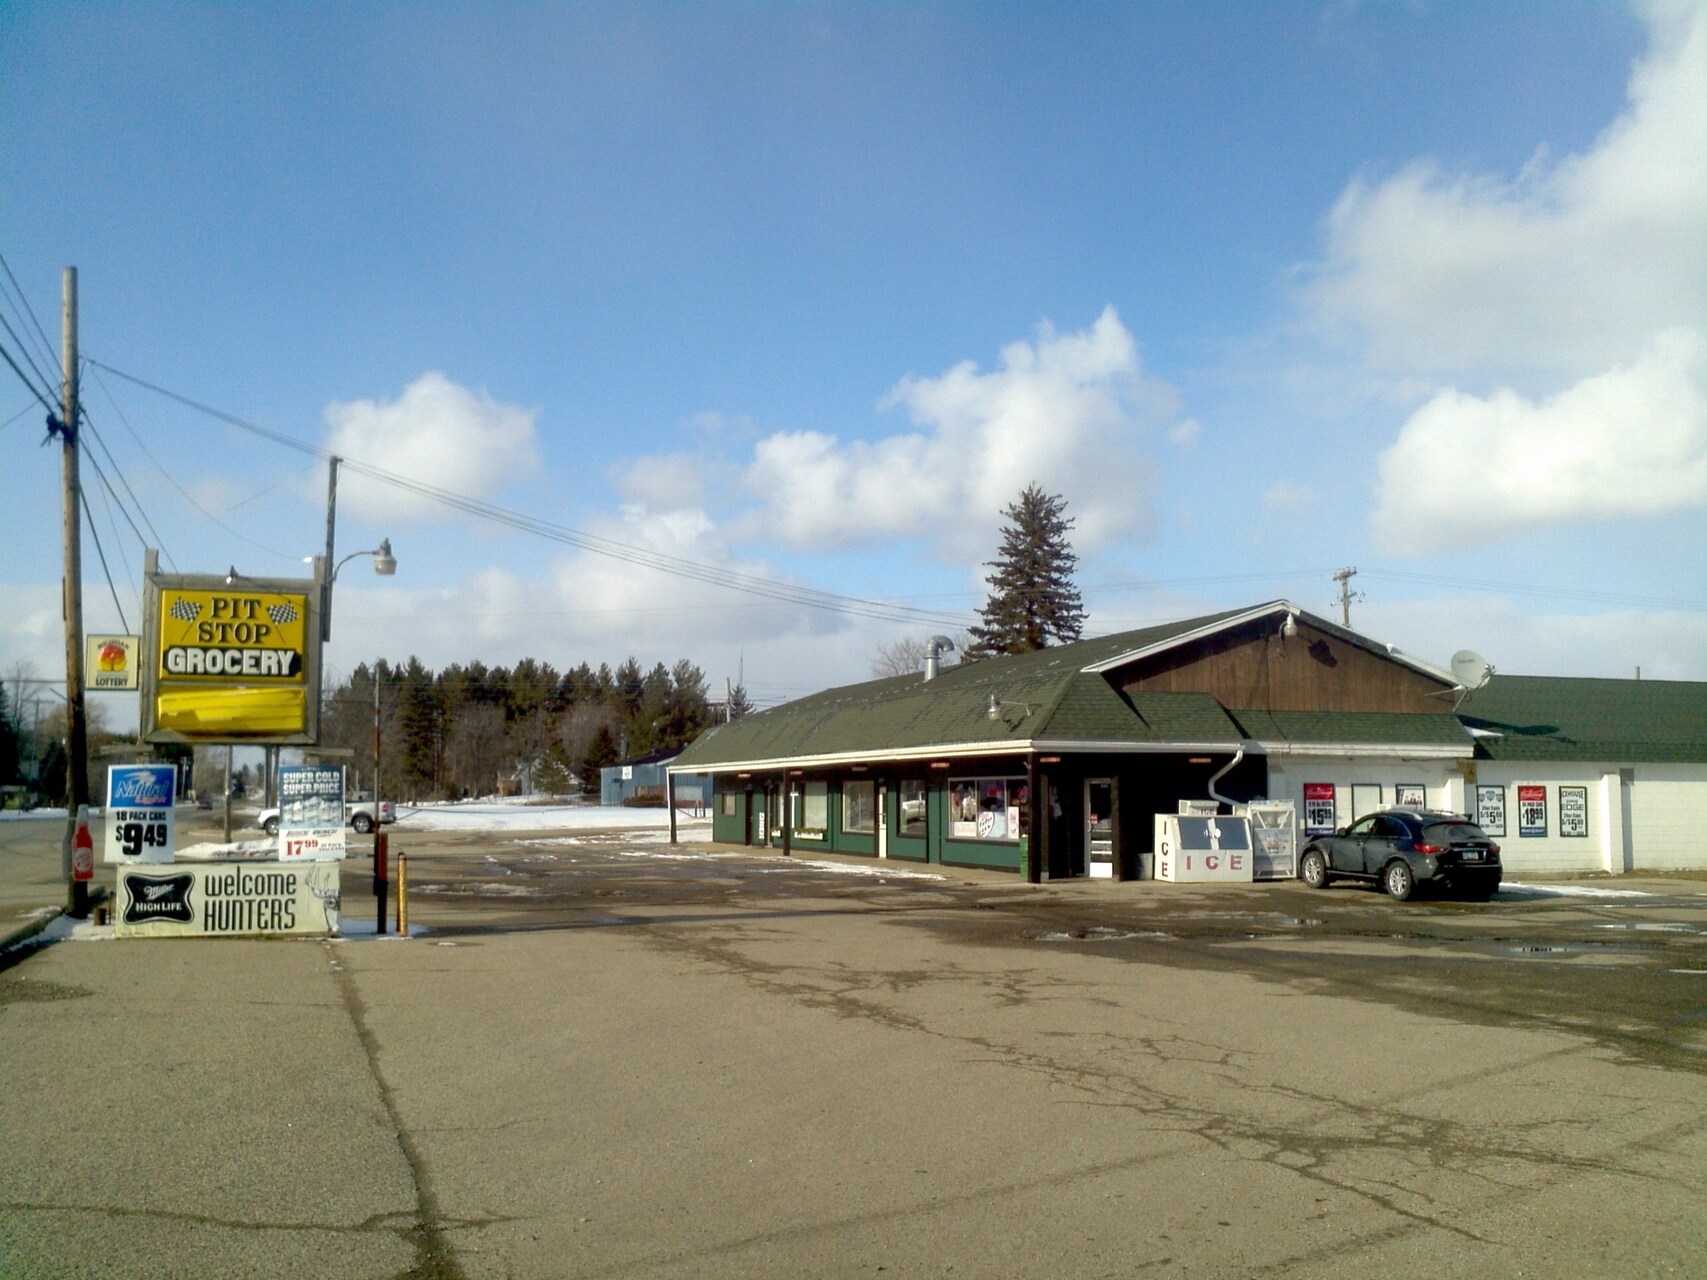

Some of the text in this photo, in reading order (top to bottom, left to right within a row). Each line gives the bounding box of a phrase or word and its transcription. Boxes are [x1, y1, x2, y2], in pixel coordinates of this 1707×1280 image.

[211, 597, 262, 619] PIT
[197, 621, 271, 644] STOP
[167, 647, 295, 676] GROCERY
[95, 677, 128, 686] LOTTERY
[283, 771, 340, 783] SUPER COLD
[283, 783, 340, 795] SUPER PRICE
[116, 811, 167, 821] 18 PACK CANS
[1200, 807, 1216, 816] ICE
[1161, 821, 1169, 878] ICE
[1186, 854, 1242, 871] ICE
[205, 865, 297, 897] welcome
[143, 883, 175, 901] Miller
[136, 902, 183, 912] HIGH LIFE
[203, 897, 296, 932] HUNTERS
